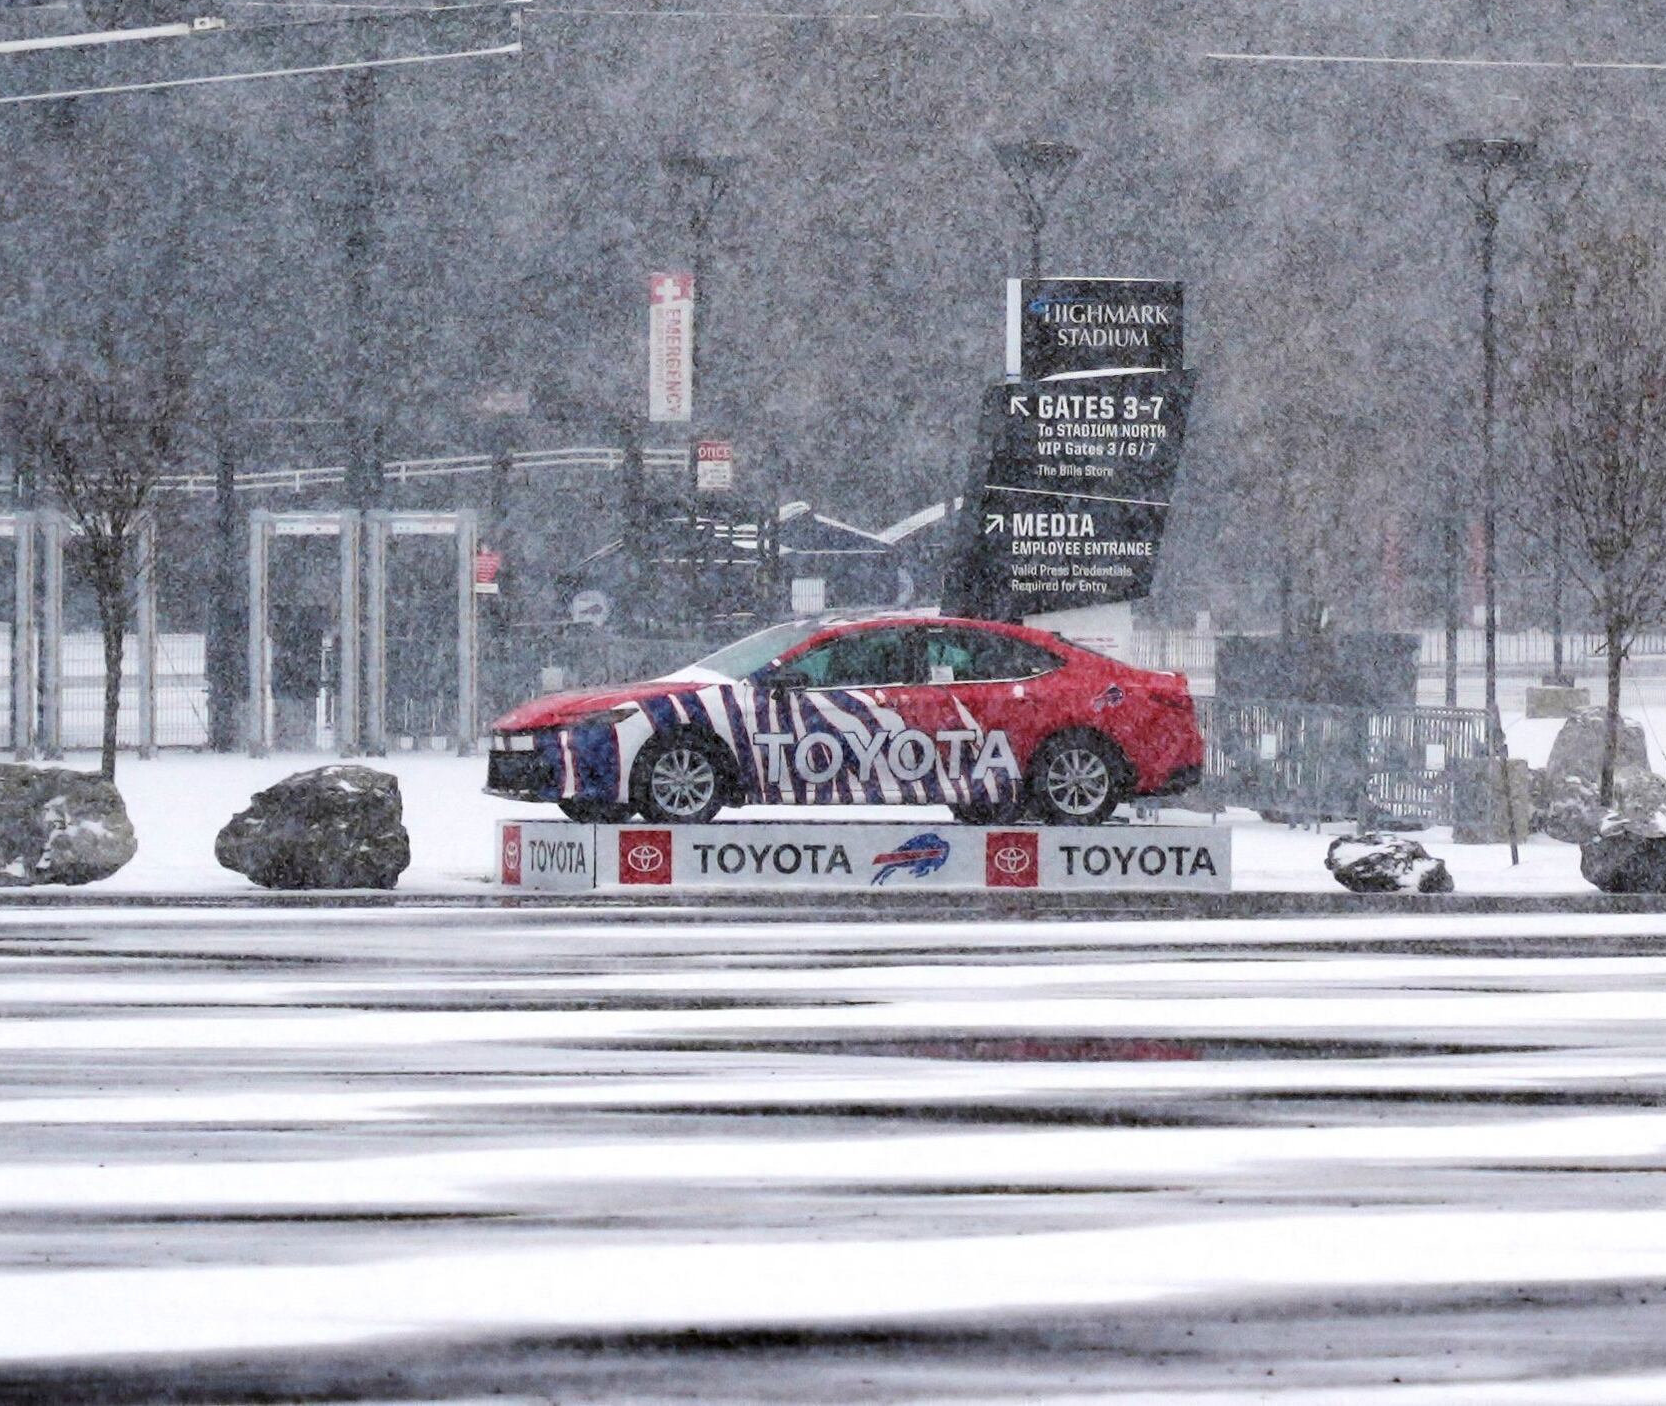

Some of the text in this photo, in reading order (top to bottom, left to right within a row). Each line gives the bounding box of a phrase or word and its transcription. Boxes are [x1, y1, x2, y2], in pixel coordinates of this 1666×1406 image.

[1044, 304, 1169, 324] HIGHMARK
[1057, 328, 1149, 347] STADIUM
[665, 308, 681, 415] EMERGENCY
[1038, 395, 1164, 420] GATES 3-7
[1038, 424, 1166, 438] To STADIUM NORTH
[1037, 442, 1061, 456] VIP
[1065, 442, 1104, 456] Gates
[1037, 464, 1114, 476] The Bills Store
[1012, 513, 1096, 537] MEDIA
[1012, 541, 1153, 556] EMPLOYEE ENTRANCE
[1011, 564, 1132, 577] Valid Press Credentials
[1011, 580, 1108, 594] Required for Entry
[753, 728, 1023, 784] TOYOTA
[528, 840, 586, 875] TOYOTA
[693, 843, 853, 875] TOYOTA
[1059, 845, 1217, 877] TOYOTA
